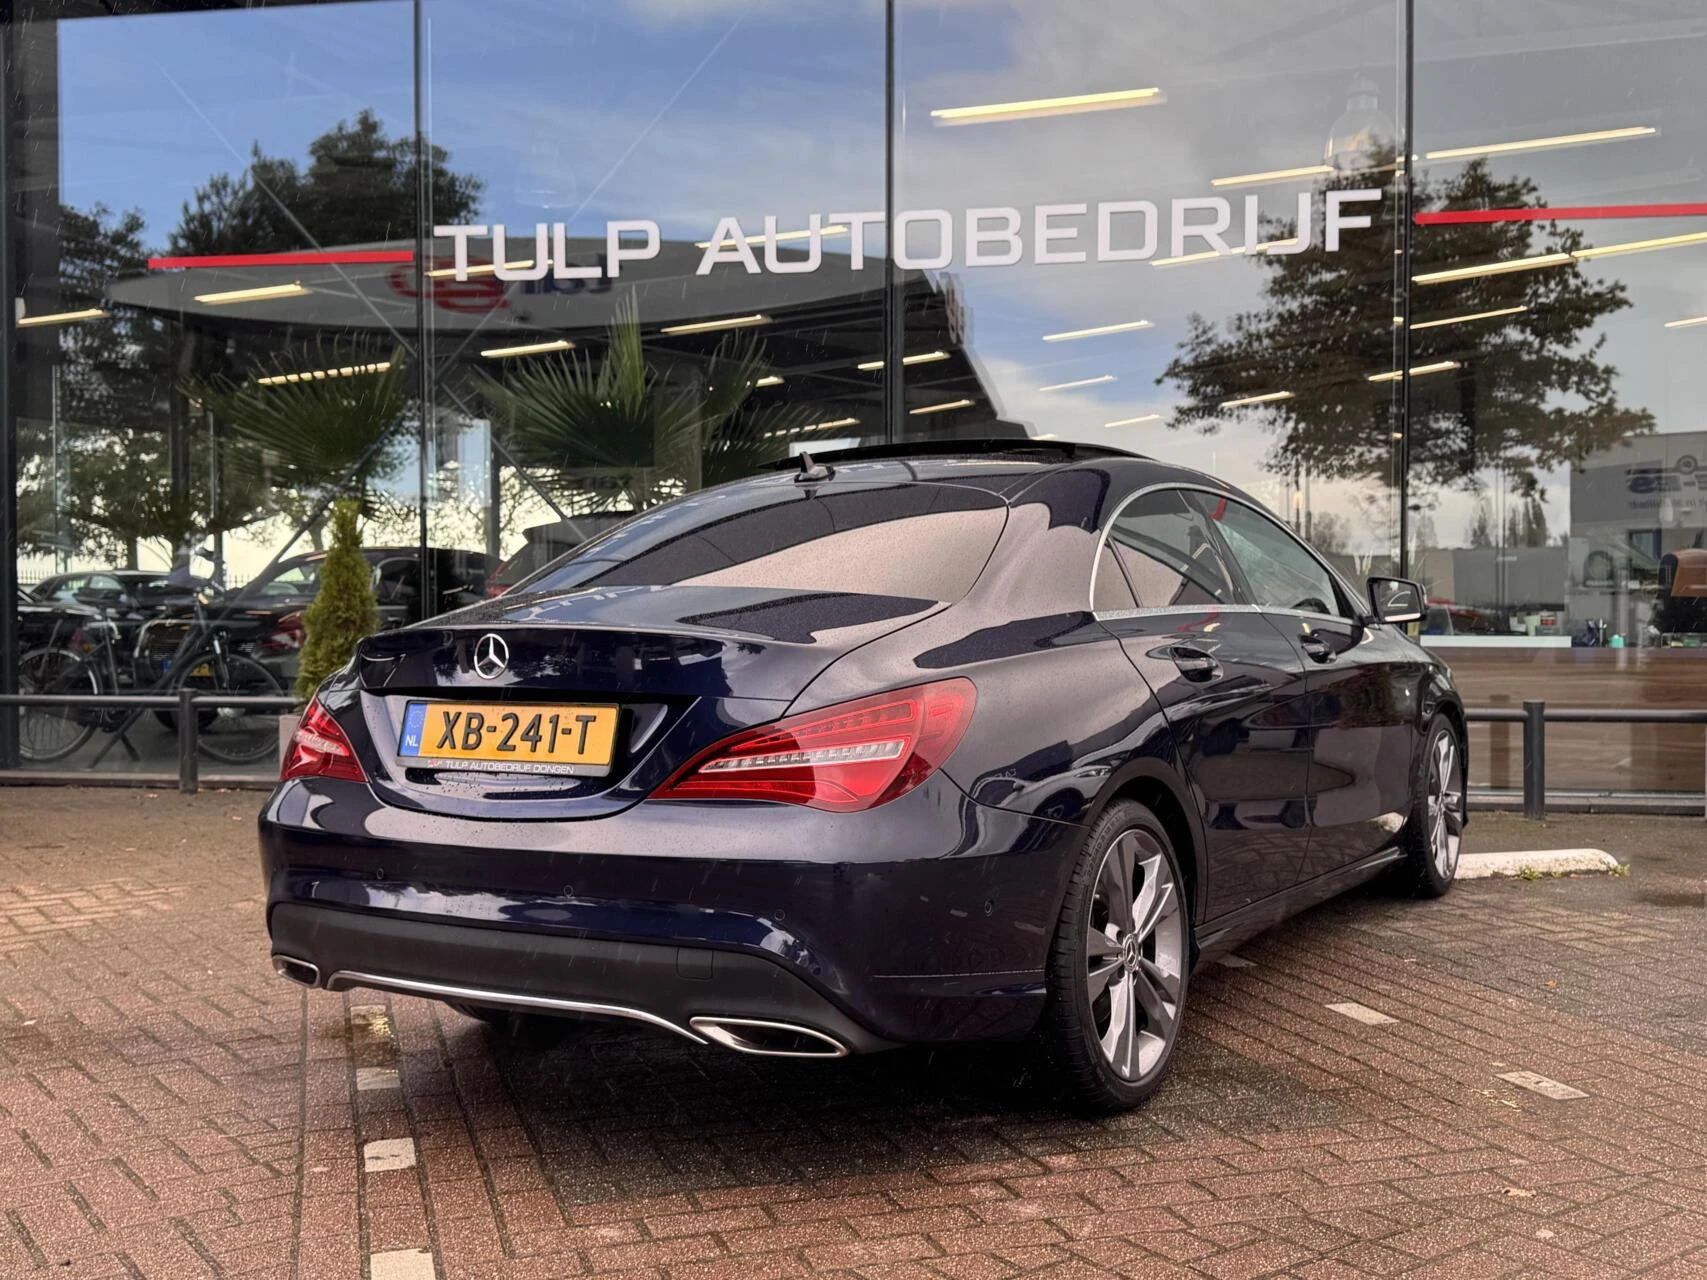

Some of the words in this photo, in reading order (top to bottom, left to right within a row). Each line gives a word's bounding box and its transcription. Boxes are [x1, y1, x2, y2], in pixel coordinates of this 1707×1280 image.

[433, 220, 661, 282] TULP
[695, 189, 1383, 276] AUTOBEDRIJF
[404, 735, 418, 747] NL
[437, 711, 596, 755] XB-241-T
[445, 760, 469, 769] TULP
[533, 765, 574, 774] DONGEN
